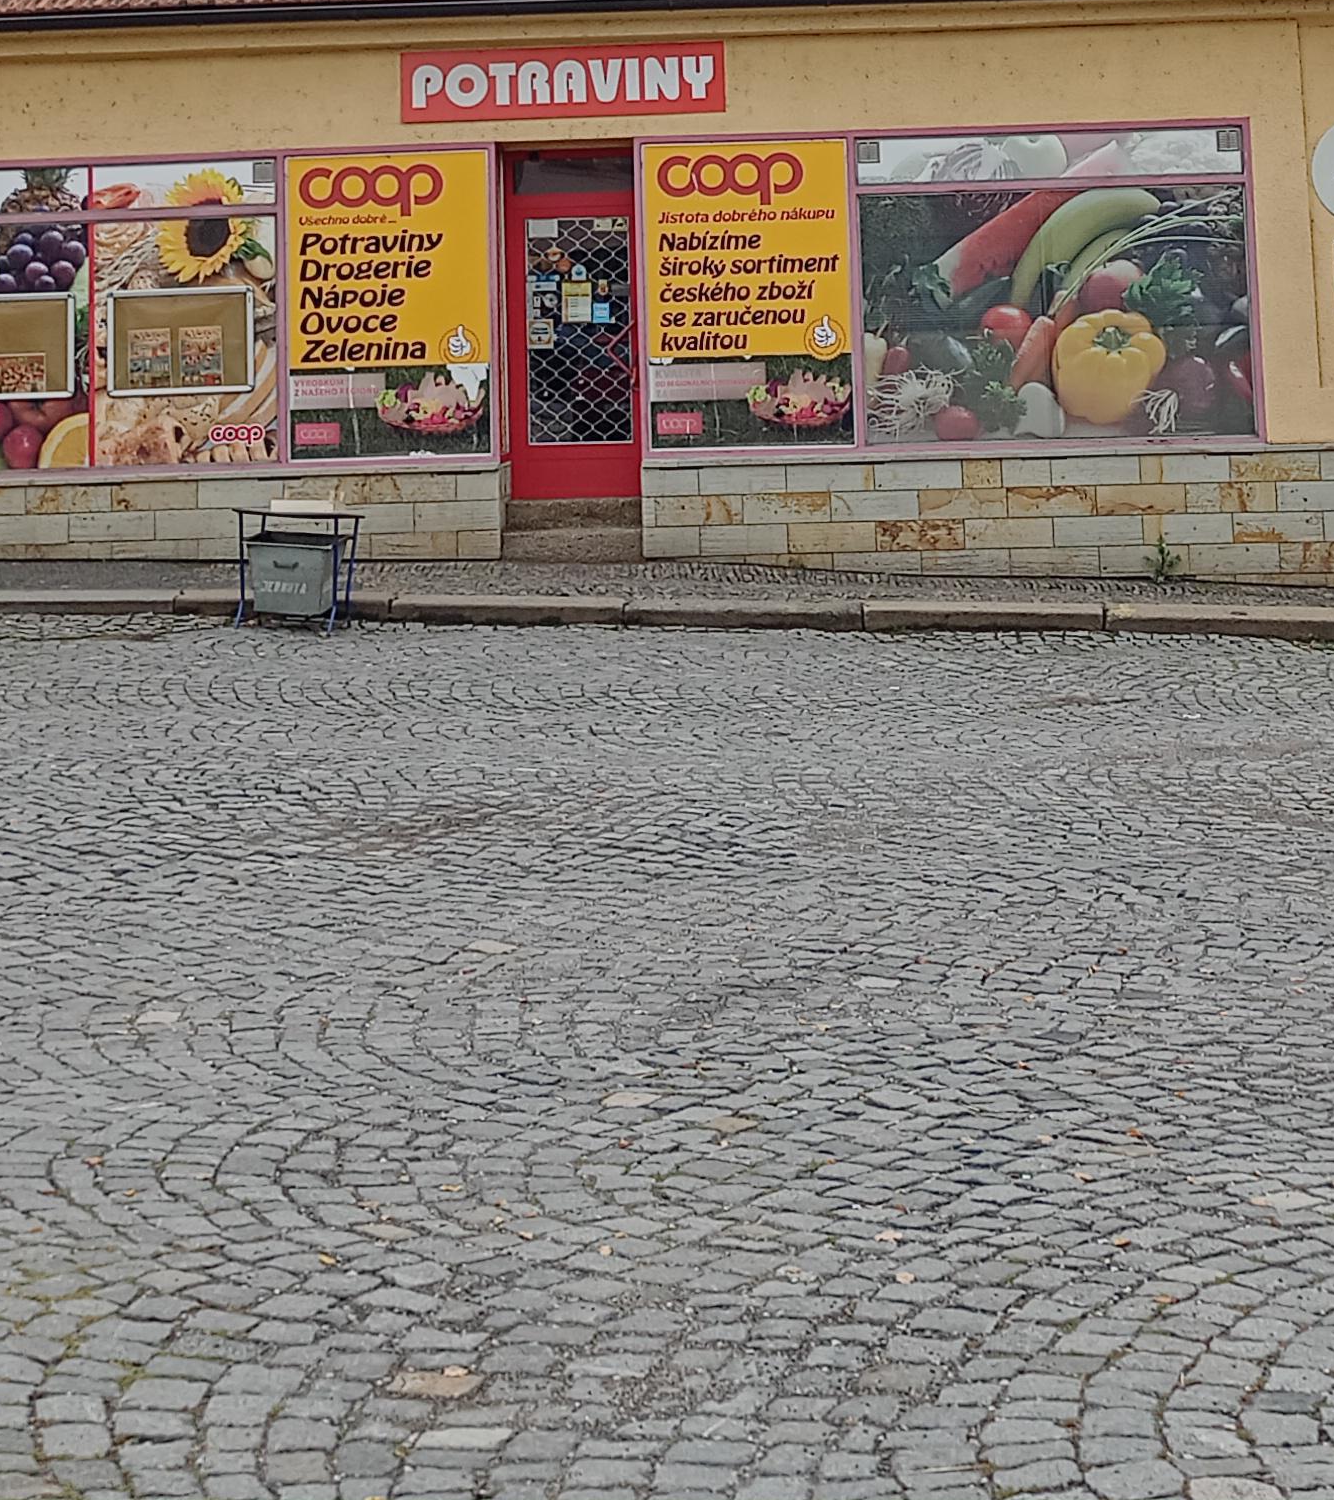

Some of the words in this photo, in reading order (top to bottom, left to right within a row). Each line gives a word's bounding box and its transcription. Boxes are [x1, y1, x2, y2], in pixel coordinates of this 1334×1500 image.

[411, 55, 714, 109] POTRAVINY
[299, 163, 443, 216] coop
[657, 152, 804, 205] coop
[658, 211, 709, 224] Jistota
[712, 208, 777, 222] dobrého
[780, 207, 835, 220] nákupu
[299, 229, 443, 256] Potraviny
[658, 229, 761, 252] Nabízíme
[299, 255, 432, 282] Drogerie
[659, 256, 726, 279] široký
[730, 253, 839, 274] sortiment
[299, 284, 405, 309] Nápoje
[659, 281, 751, 303] českého
[756, 280, 815, 300] zboží
[300, 311, 398, 335] Ovoce
[660, 311, 686, 328] se
[691, 305, 805, 327] zaručenou
[300, 336, 426, 363] Zelenina
[660, 331, 747, 352] kvalitou
[210, 425, 263, 445] coop
